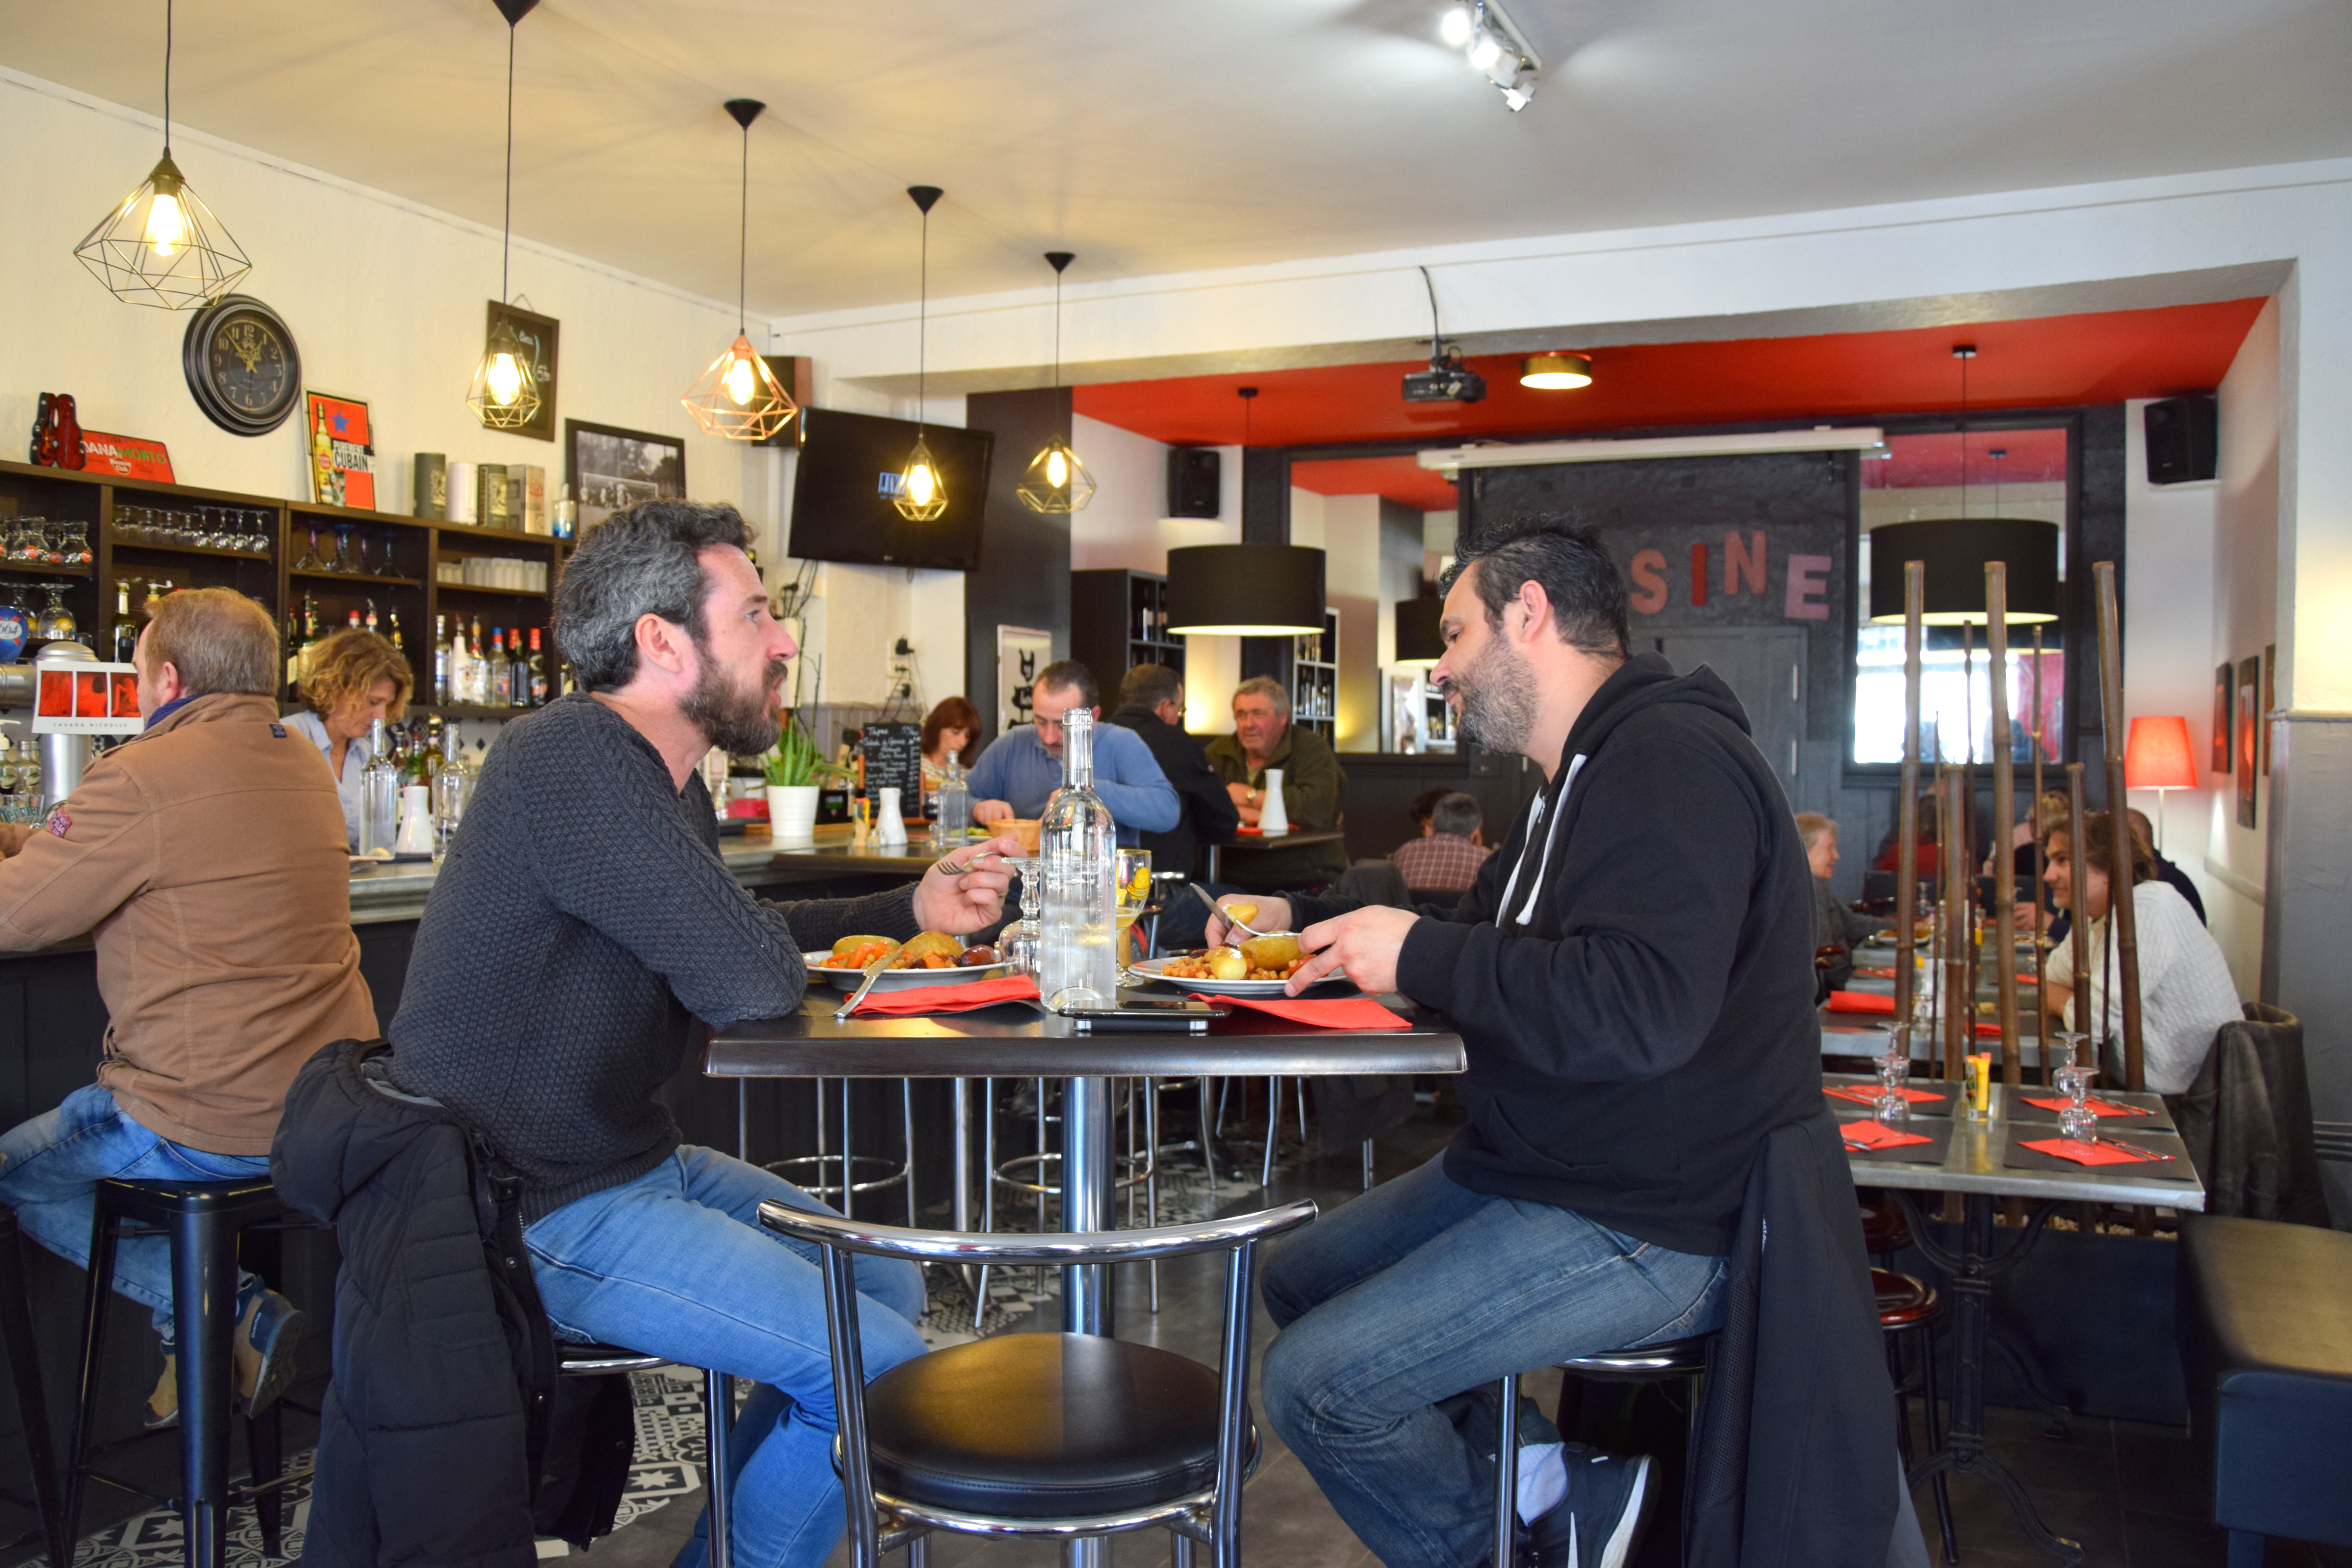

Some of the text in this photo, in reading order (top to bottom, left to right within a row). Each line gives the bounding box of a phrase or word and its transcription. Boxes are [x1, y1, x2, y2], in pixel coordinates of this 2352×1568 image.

[231, 327, 239, 339] 11
[263, 333, 267, 345] 1
[218, 338, 229, 350] 10
[271, 348, 278, 359] 2
[214, 354, 222, 367] 9
[275, 364, 282, 377] 3
[219, 372, 227, 384] 8
[229, 386, 237, 399] 7
[269, 381, 277, 392] 4
[245, 394, 252, 406] 6
[260, 392, 267, 404] 5
[335, 452, 368, 472] CUBAIN
